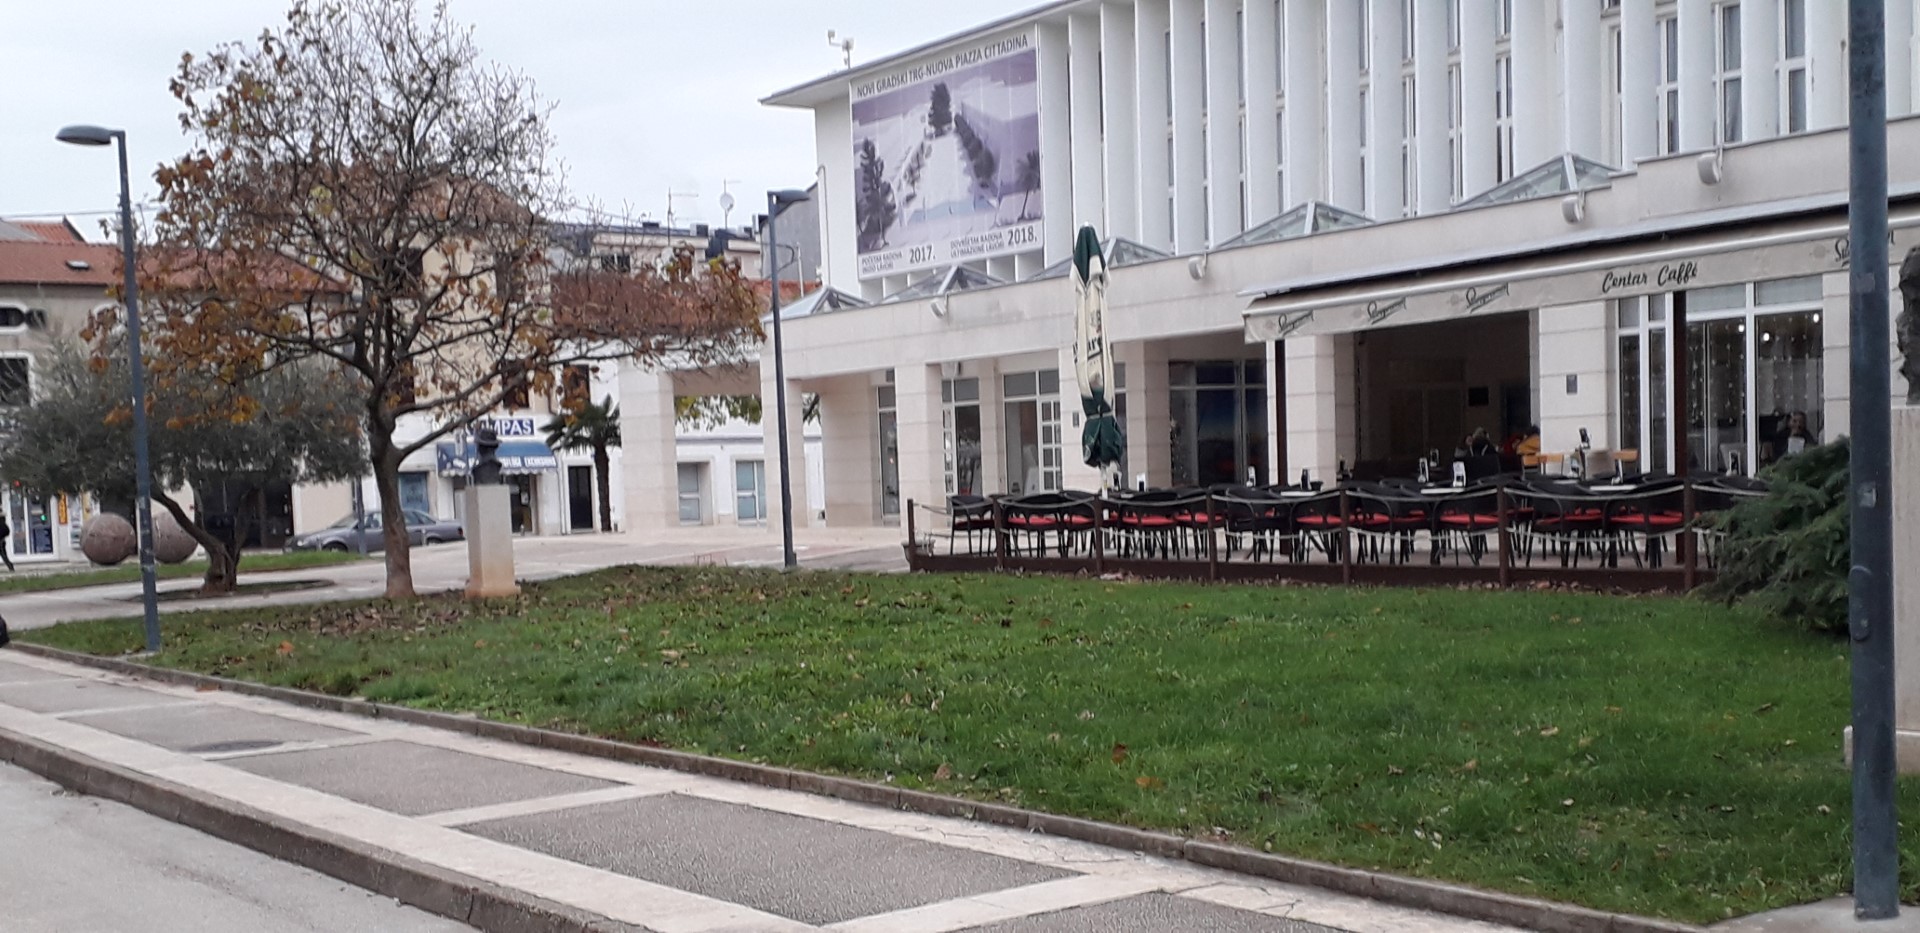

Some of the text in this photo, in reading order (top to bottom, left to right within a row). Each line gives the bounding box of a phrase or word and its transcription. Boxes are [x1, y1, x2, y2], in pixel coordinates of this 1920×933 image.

[857, 82, 875, 97] NOVI
[876, 71, 908, 93] GRADSKI
[955, 47, 983, 69] PIAZZA
[984, 33, 1028, 60] CITTADINA
[1007, 225, 1038, 247] 2018.
[909, 244, 936, 264] 2017.
[1602, 271, 1648, 293] Centar
